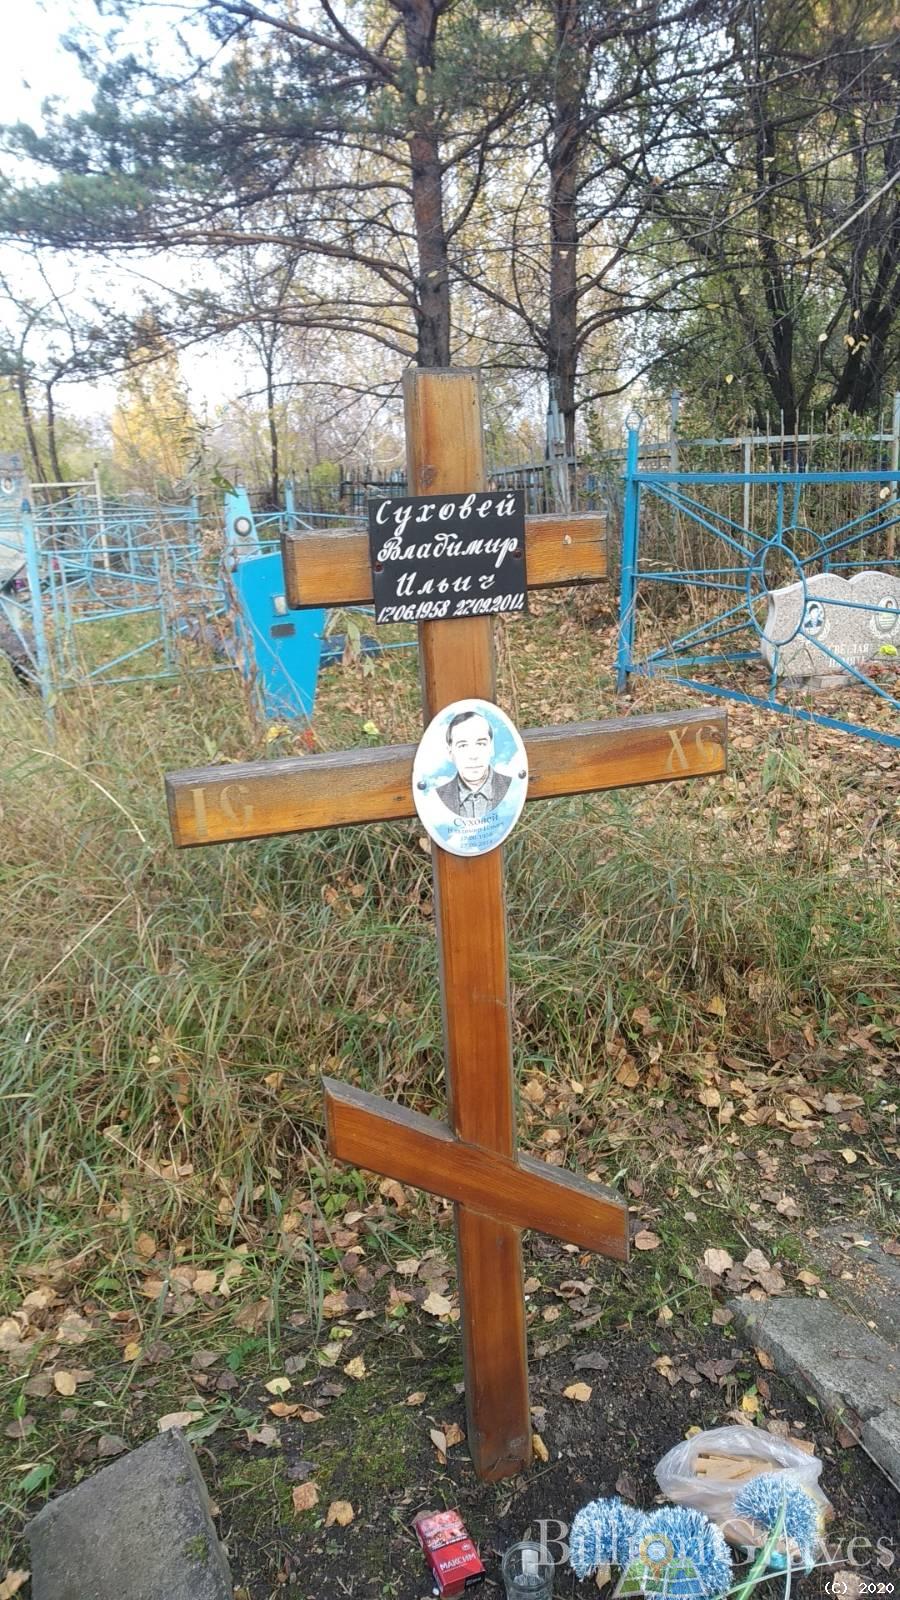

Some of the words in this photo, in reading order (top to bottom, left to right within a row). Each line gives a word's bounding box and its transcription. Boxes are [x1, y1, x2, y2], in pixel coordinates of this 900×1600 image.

[375, 493, 517, 537] Суховей
[376, 532, 519, 569] Владимир
[396, 572, 496, 597] Ильич
[439, 1553, 476, 1571] МАКСИМ
